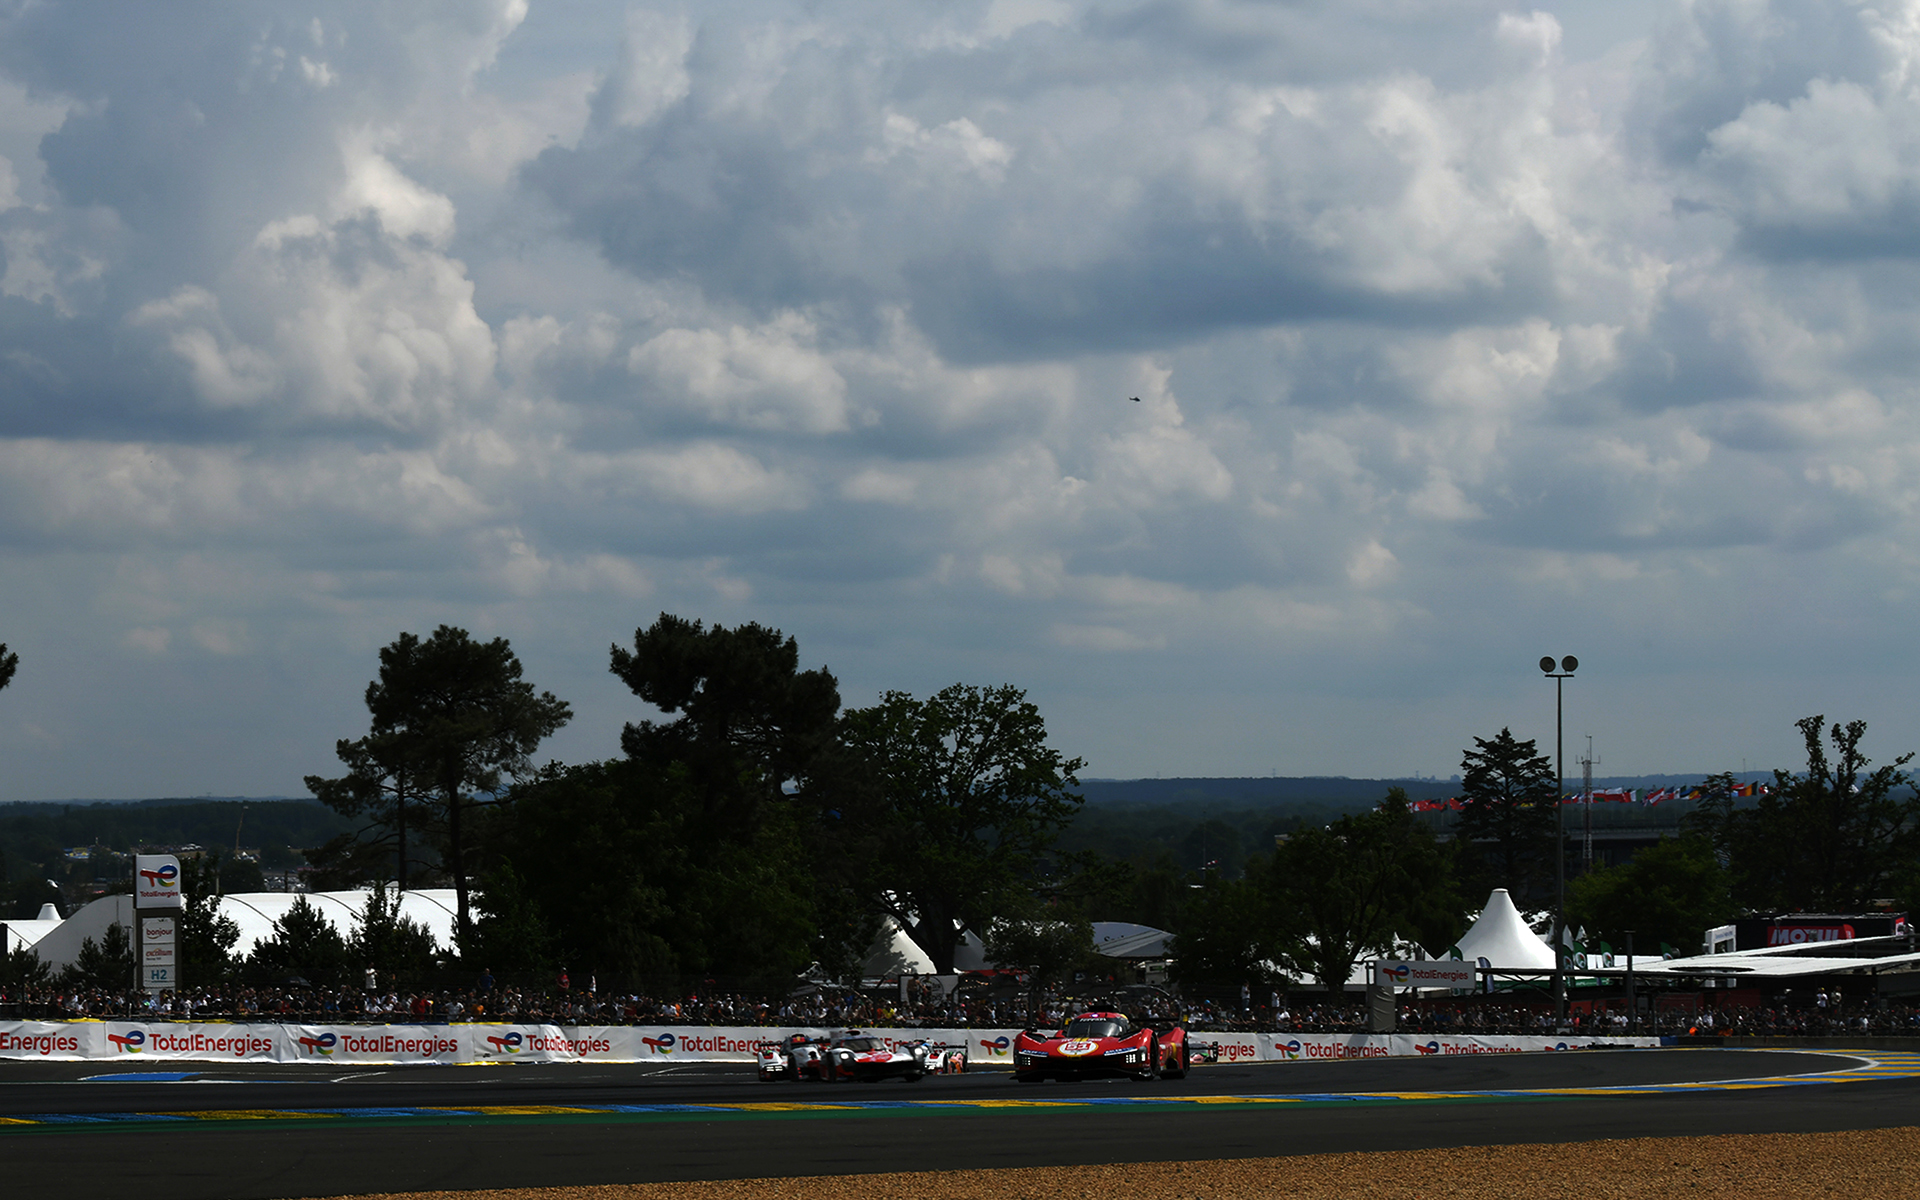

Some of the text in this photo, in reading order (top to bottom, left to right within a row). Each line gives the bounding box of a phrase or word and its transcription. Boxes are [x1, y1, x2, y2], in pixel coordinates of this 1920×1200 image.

[140, 890, 178, 898] TotalEnergies
[146, 928, 173, 937] bonjour
[151, 969, 167, 980] H2
[1411, 969, 1468, 982] TotalEnergies
[149, 1034, 272, 1056] TotalEnergies
[341, 1035, 458, 1057] TotalEnergies
[526, 1035, 610, 1056] TotalEnergies
[1201, 1041, 1255, 1061] ergies
